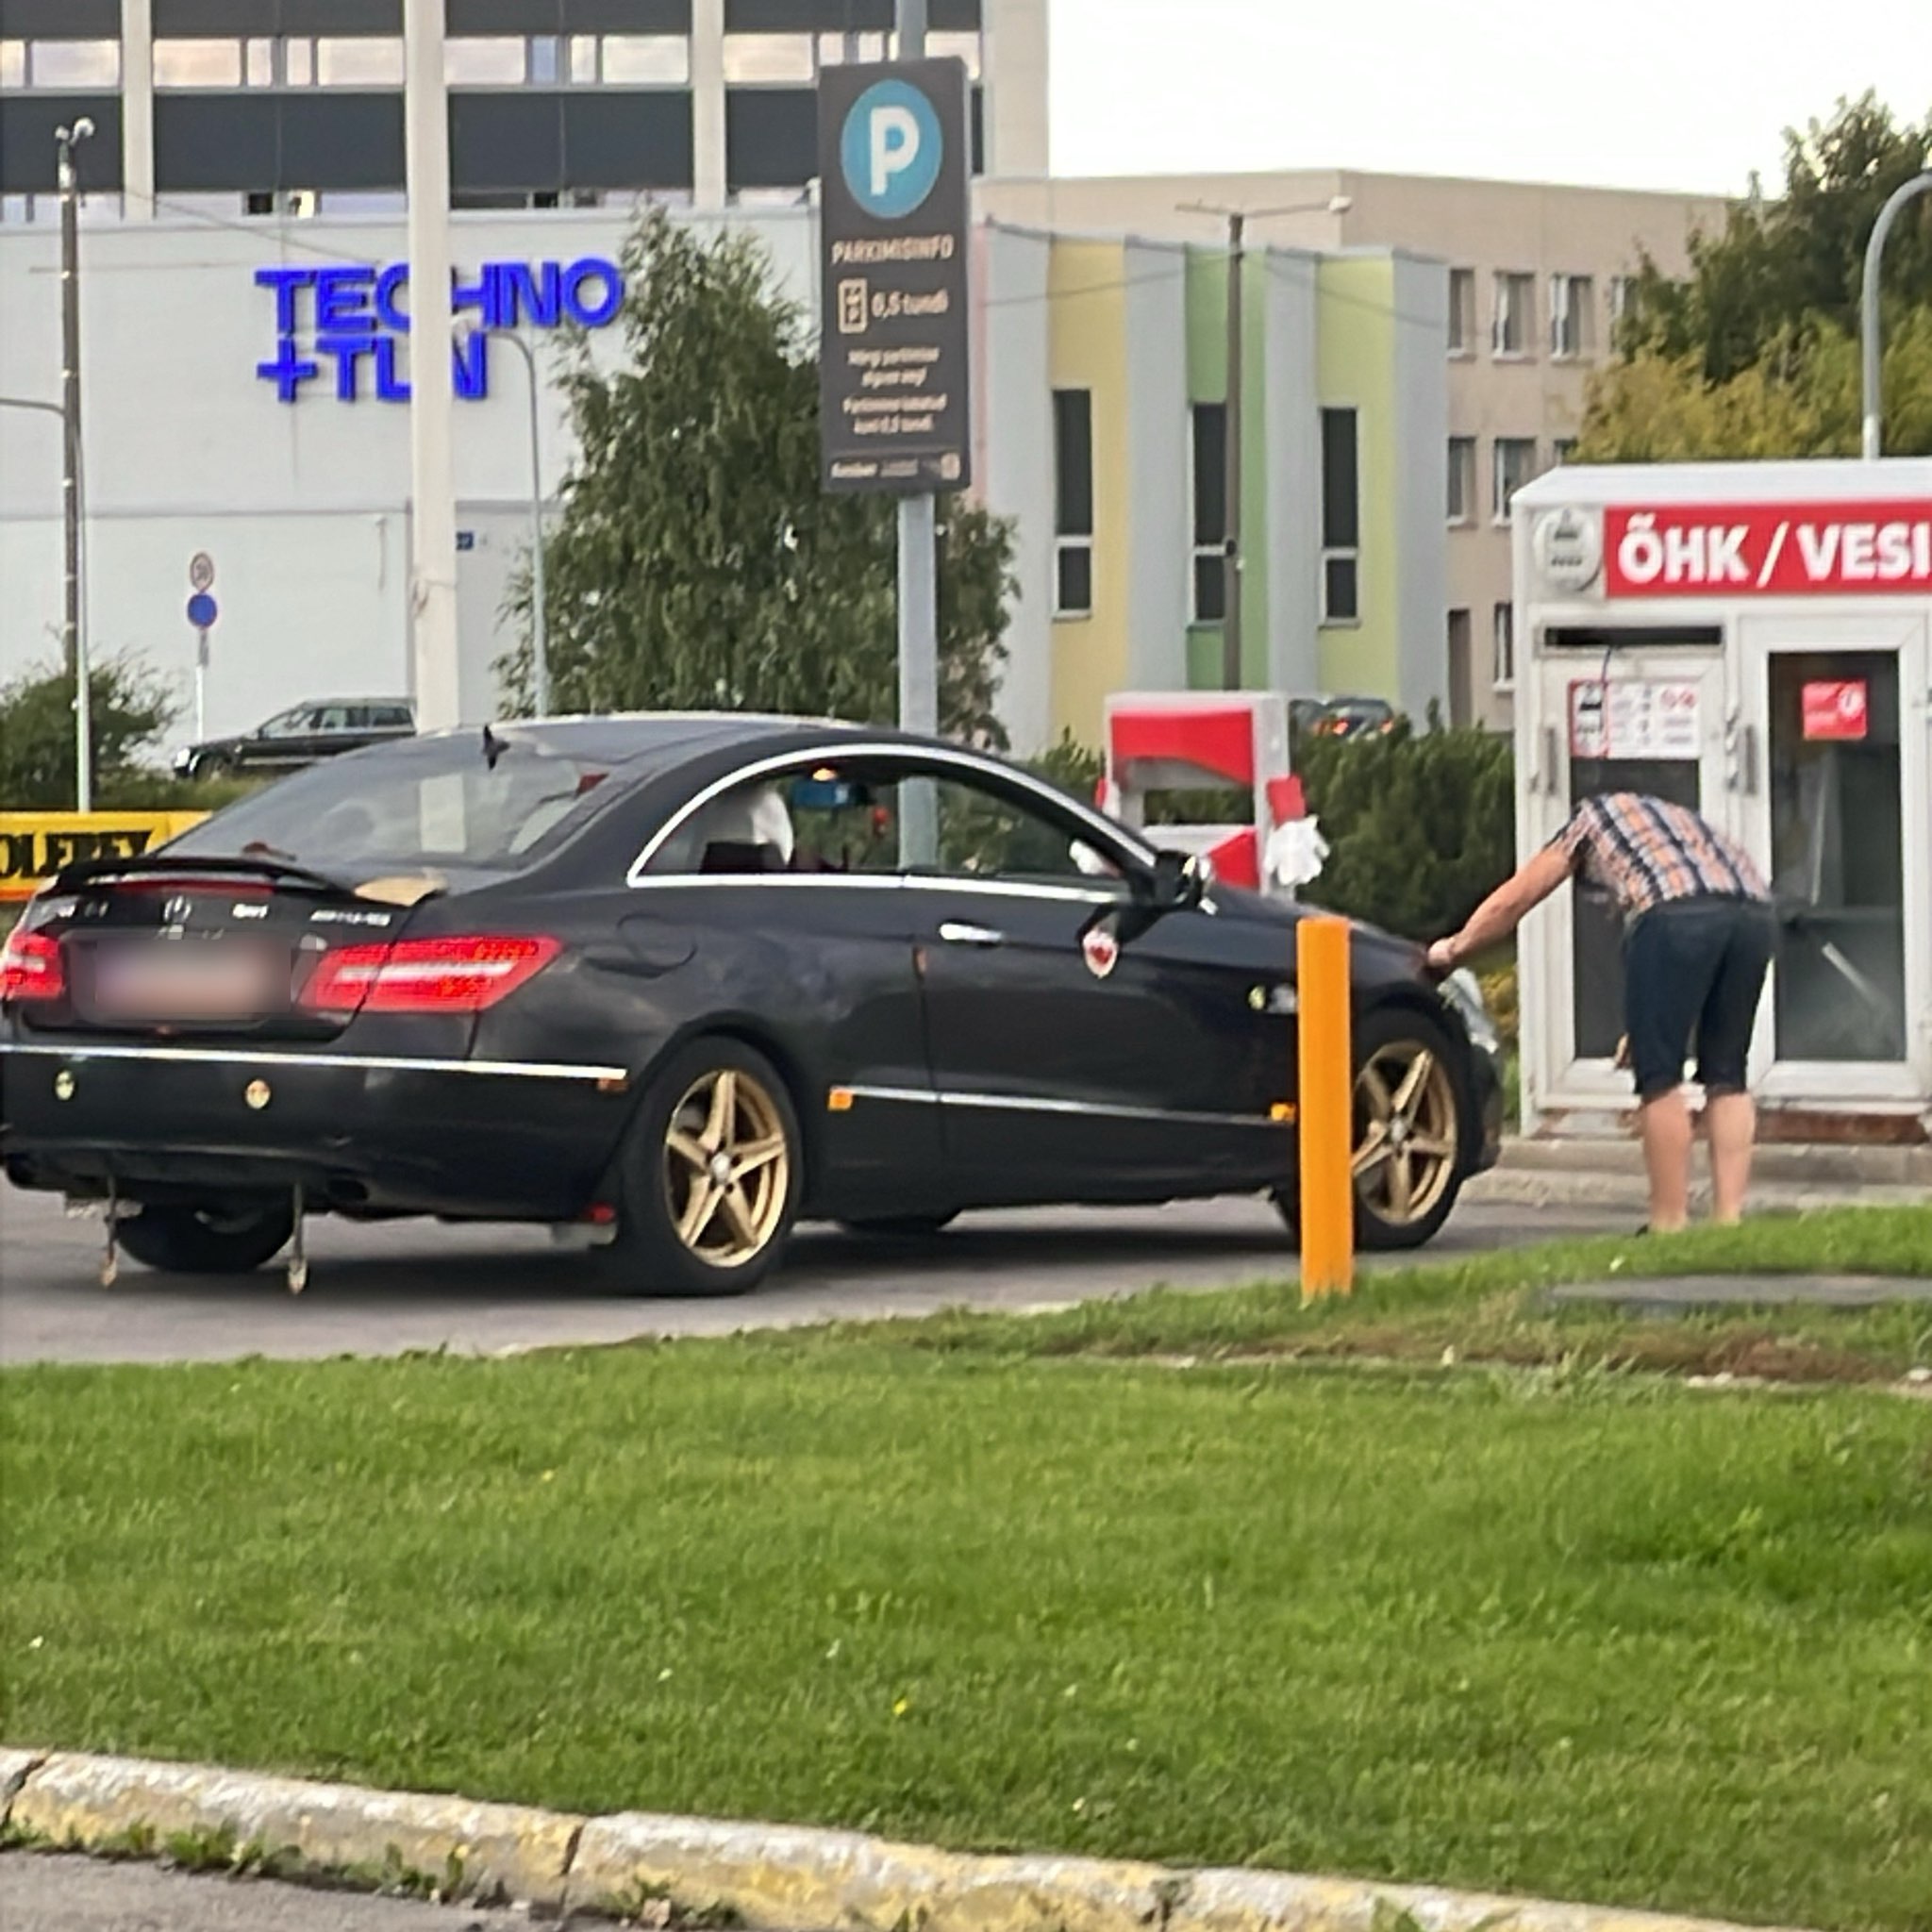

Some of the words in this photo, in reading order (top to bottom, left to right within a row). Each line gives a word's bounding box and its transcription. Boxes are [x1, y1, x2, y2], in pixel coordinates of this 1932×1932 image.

[870, 106, 920, 196] P
[255, 257, 625, 333] TECHNO
[1618, 512, 1750, 584] ÕHK
[1755, 520, 1790, 590] /
[1795, 520, 1931, 581] VESI
